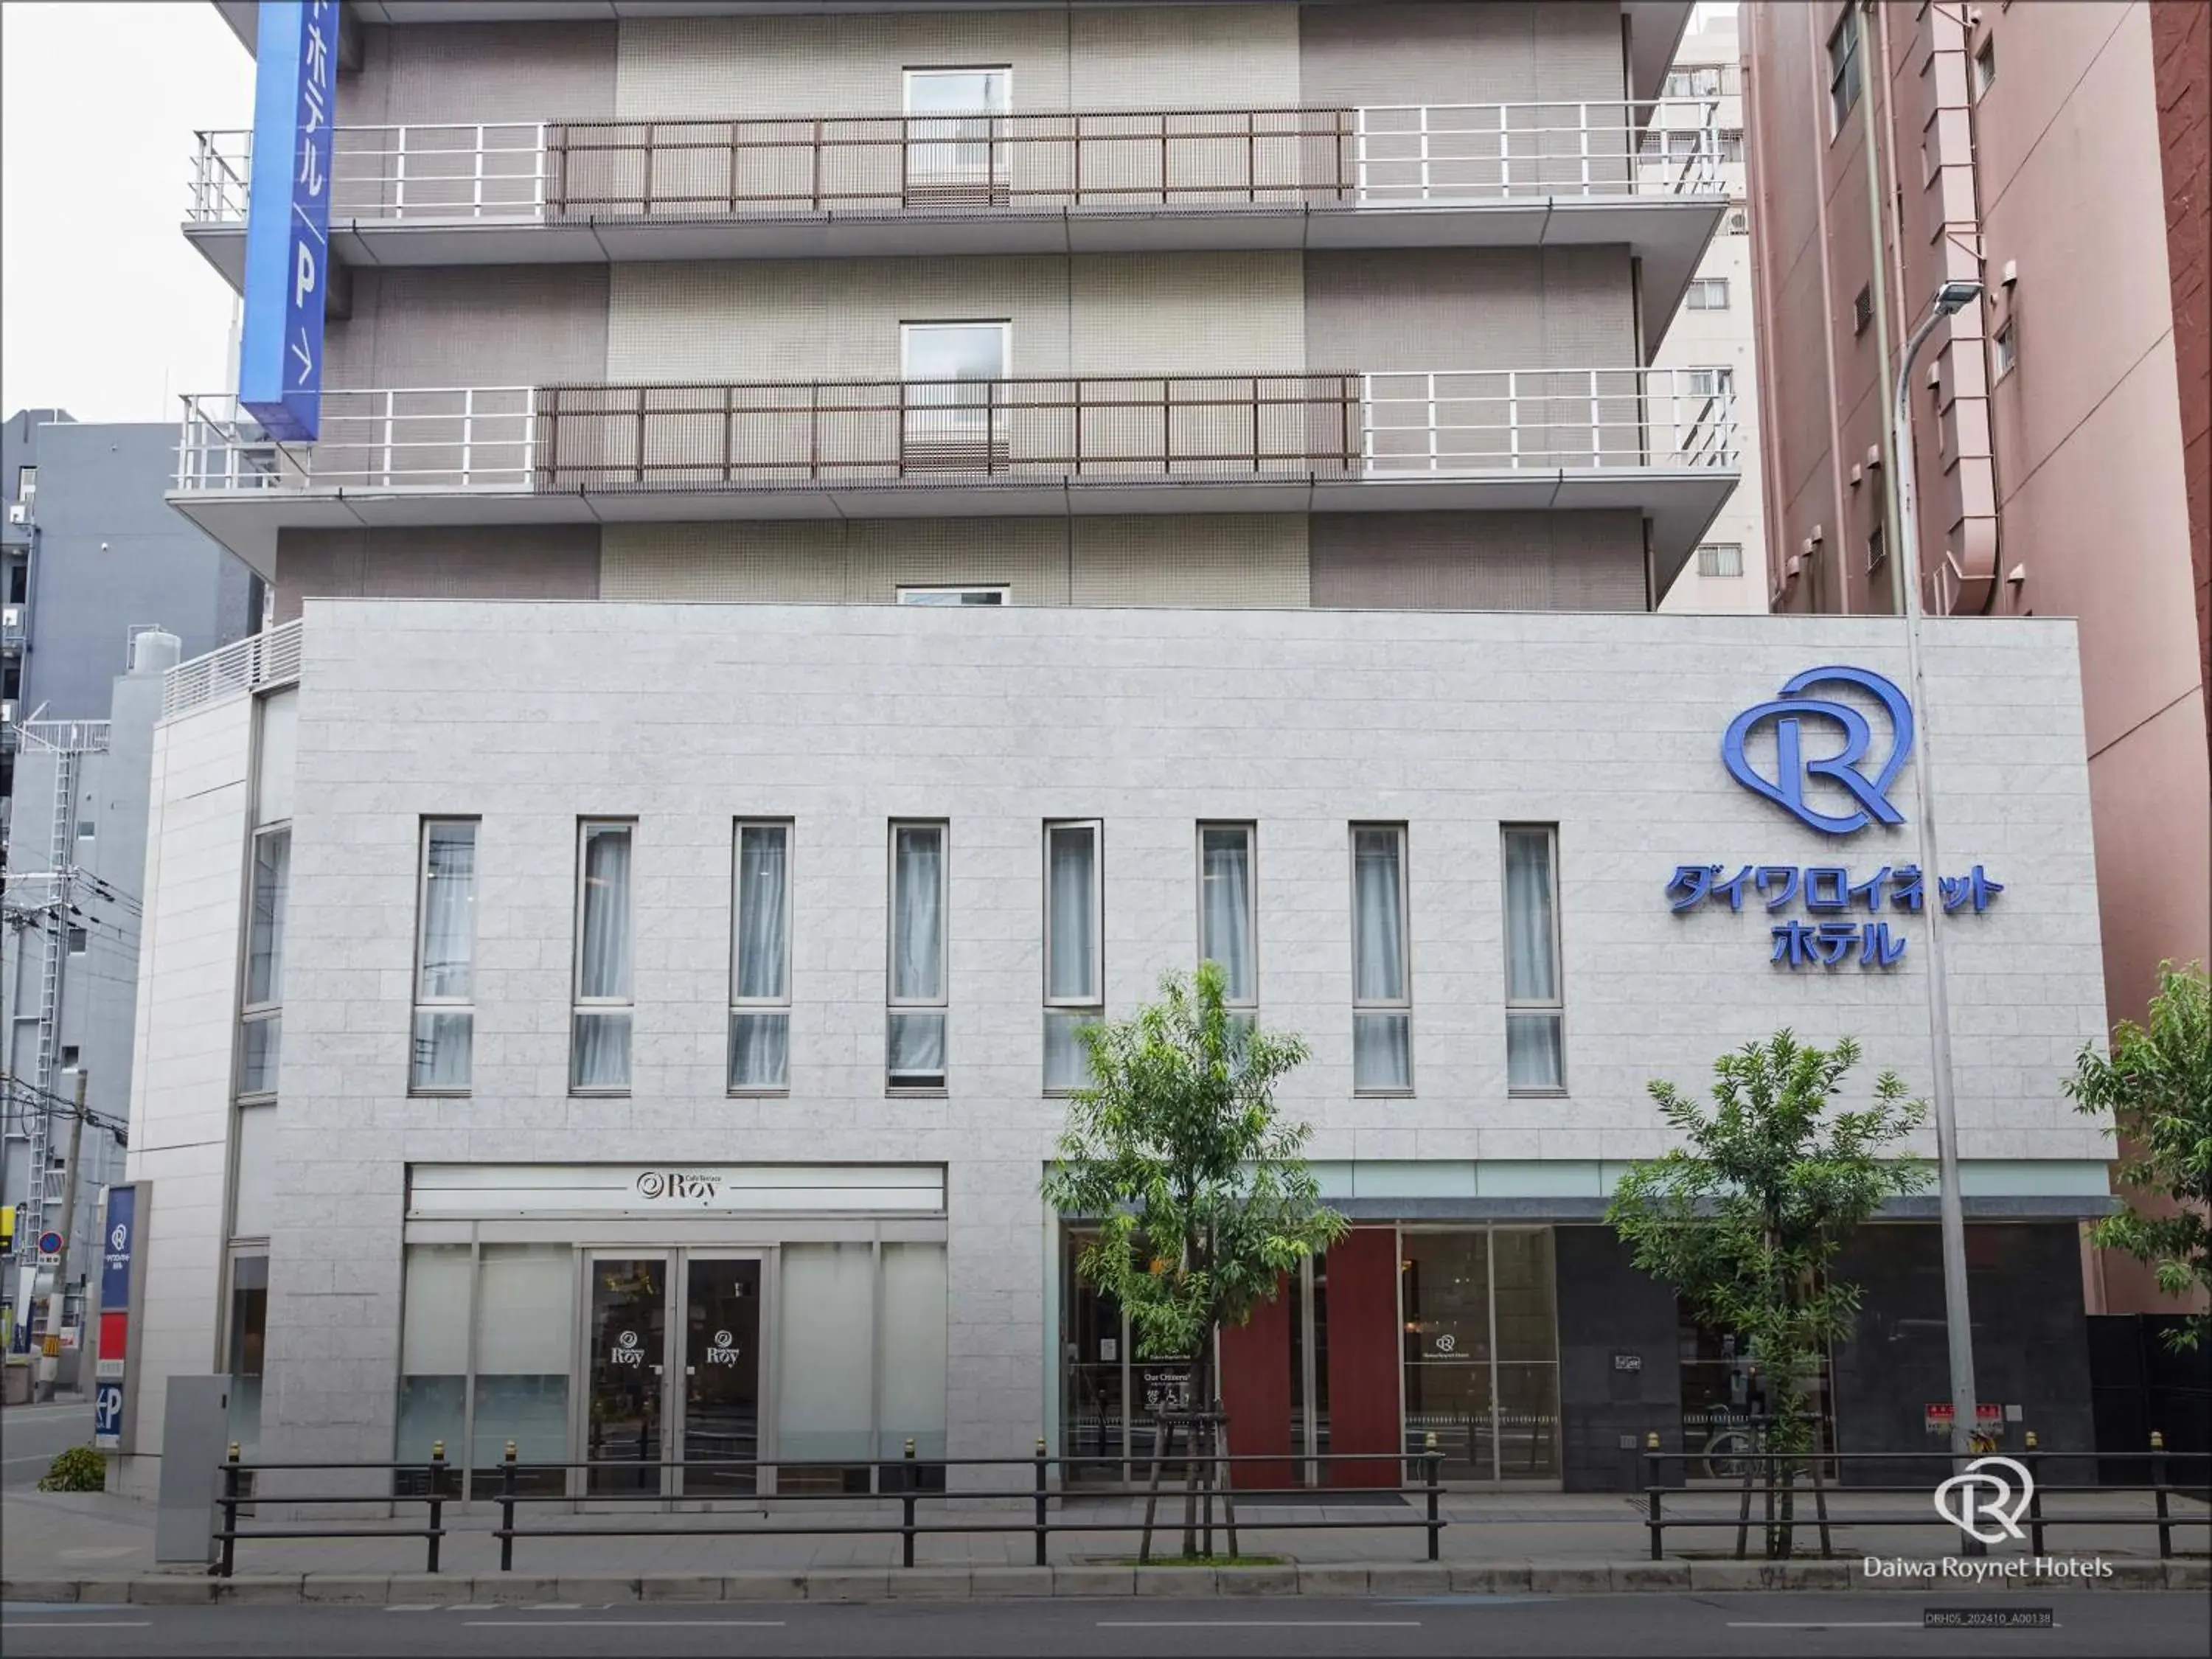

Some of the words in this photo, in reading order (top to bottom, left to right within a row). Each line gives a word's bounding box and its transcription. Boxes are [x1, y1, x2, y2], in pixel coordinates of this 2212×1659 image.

[1668, 864, 2004, 914] ダイワロイネット
[1770, 920, 1907, 969] ホテル
[668, 1173, 718, 1206] Roy
[611, 1347, 644, 1368] Roy
[707, 1347, 740, 1368] Roy
[106, 1388, 122, 1429] P
